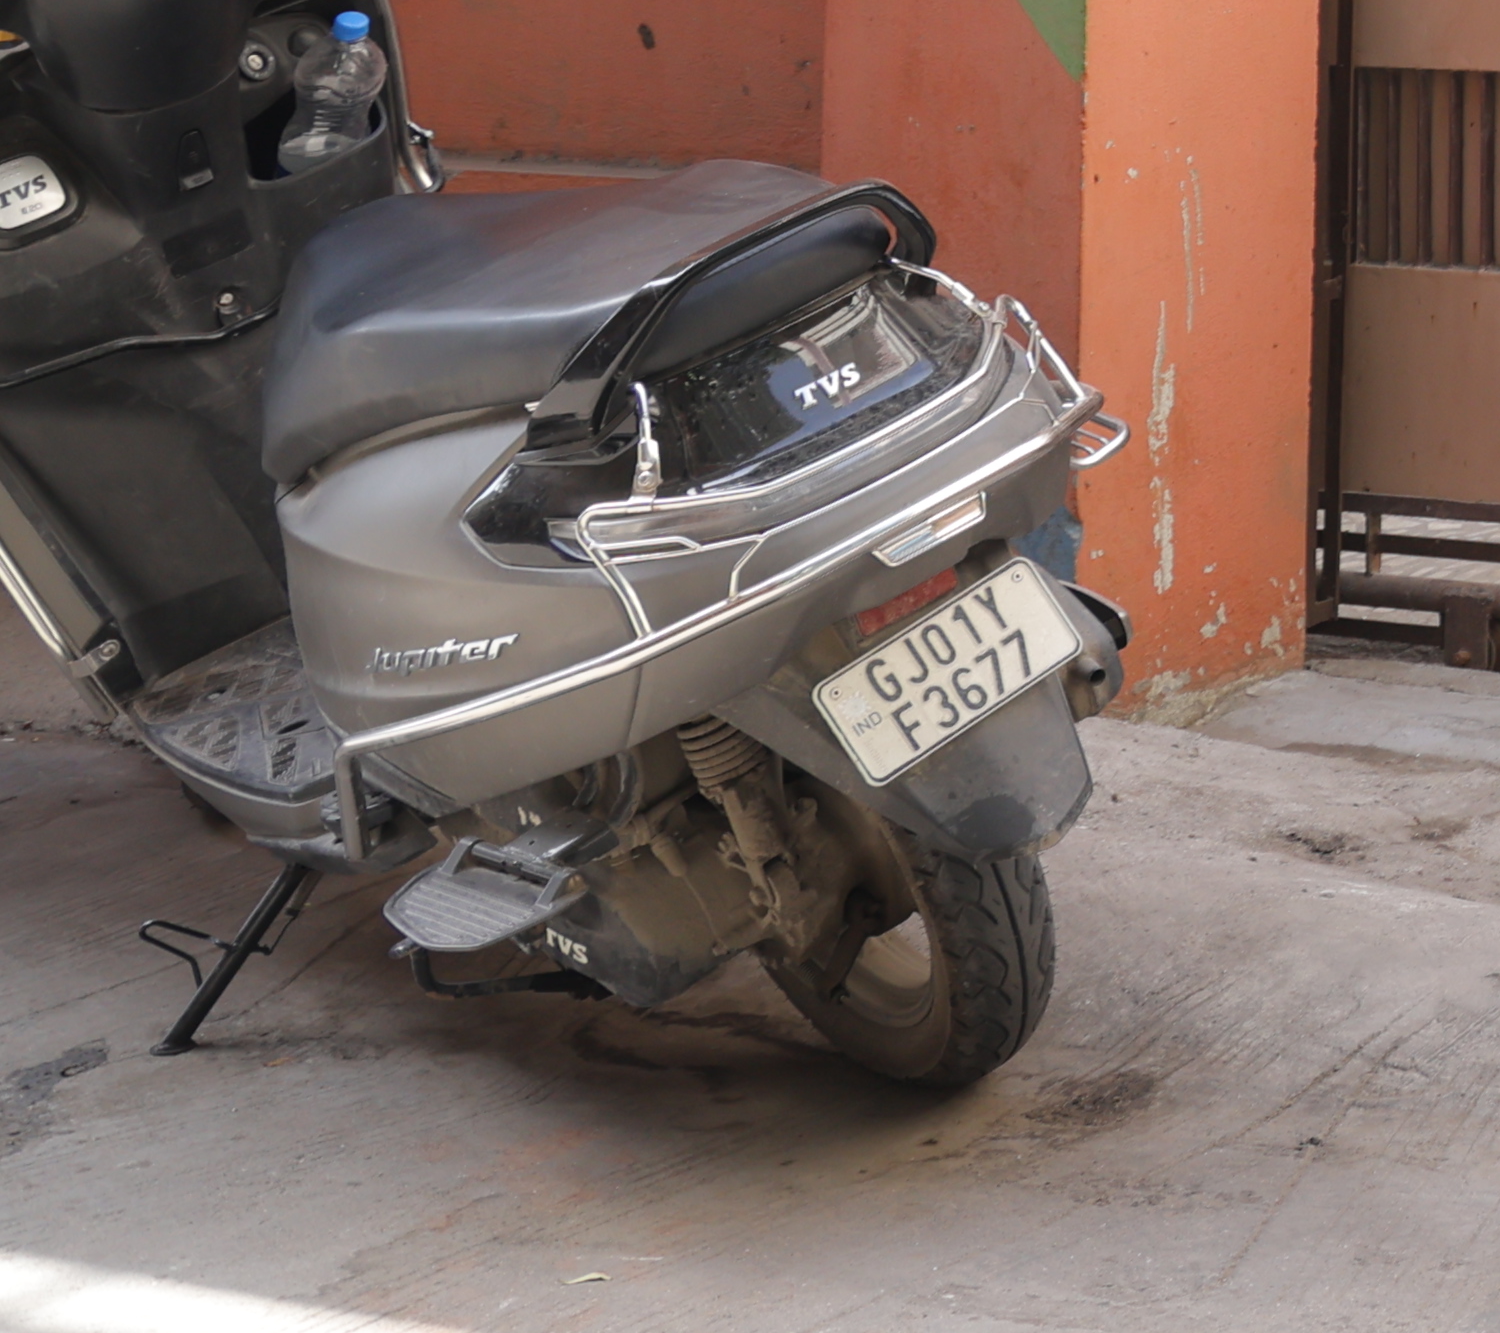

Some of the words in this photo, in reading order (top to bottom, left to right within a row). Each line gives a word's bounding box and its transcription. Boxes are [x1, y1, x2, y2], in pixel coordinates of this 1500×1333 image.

[0, 174, 47, 209] TVS
[793, 362, 861, 411] TVS
[364, 633, 519, 677] Jupiter
[852, 710, 883, 738] IND
[546, 927, 589, 965] TVS
